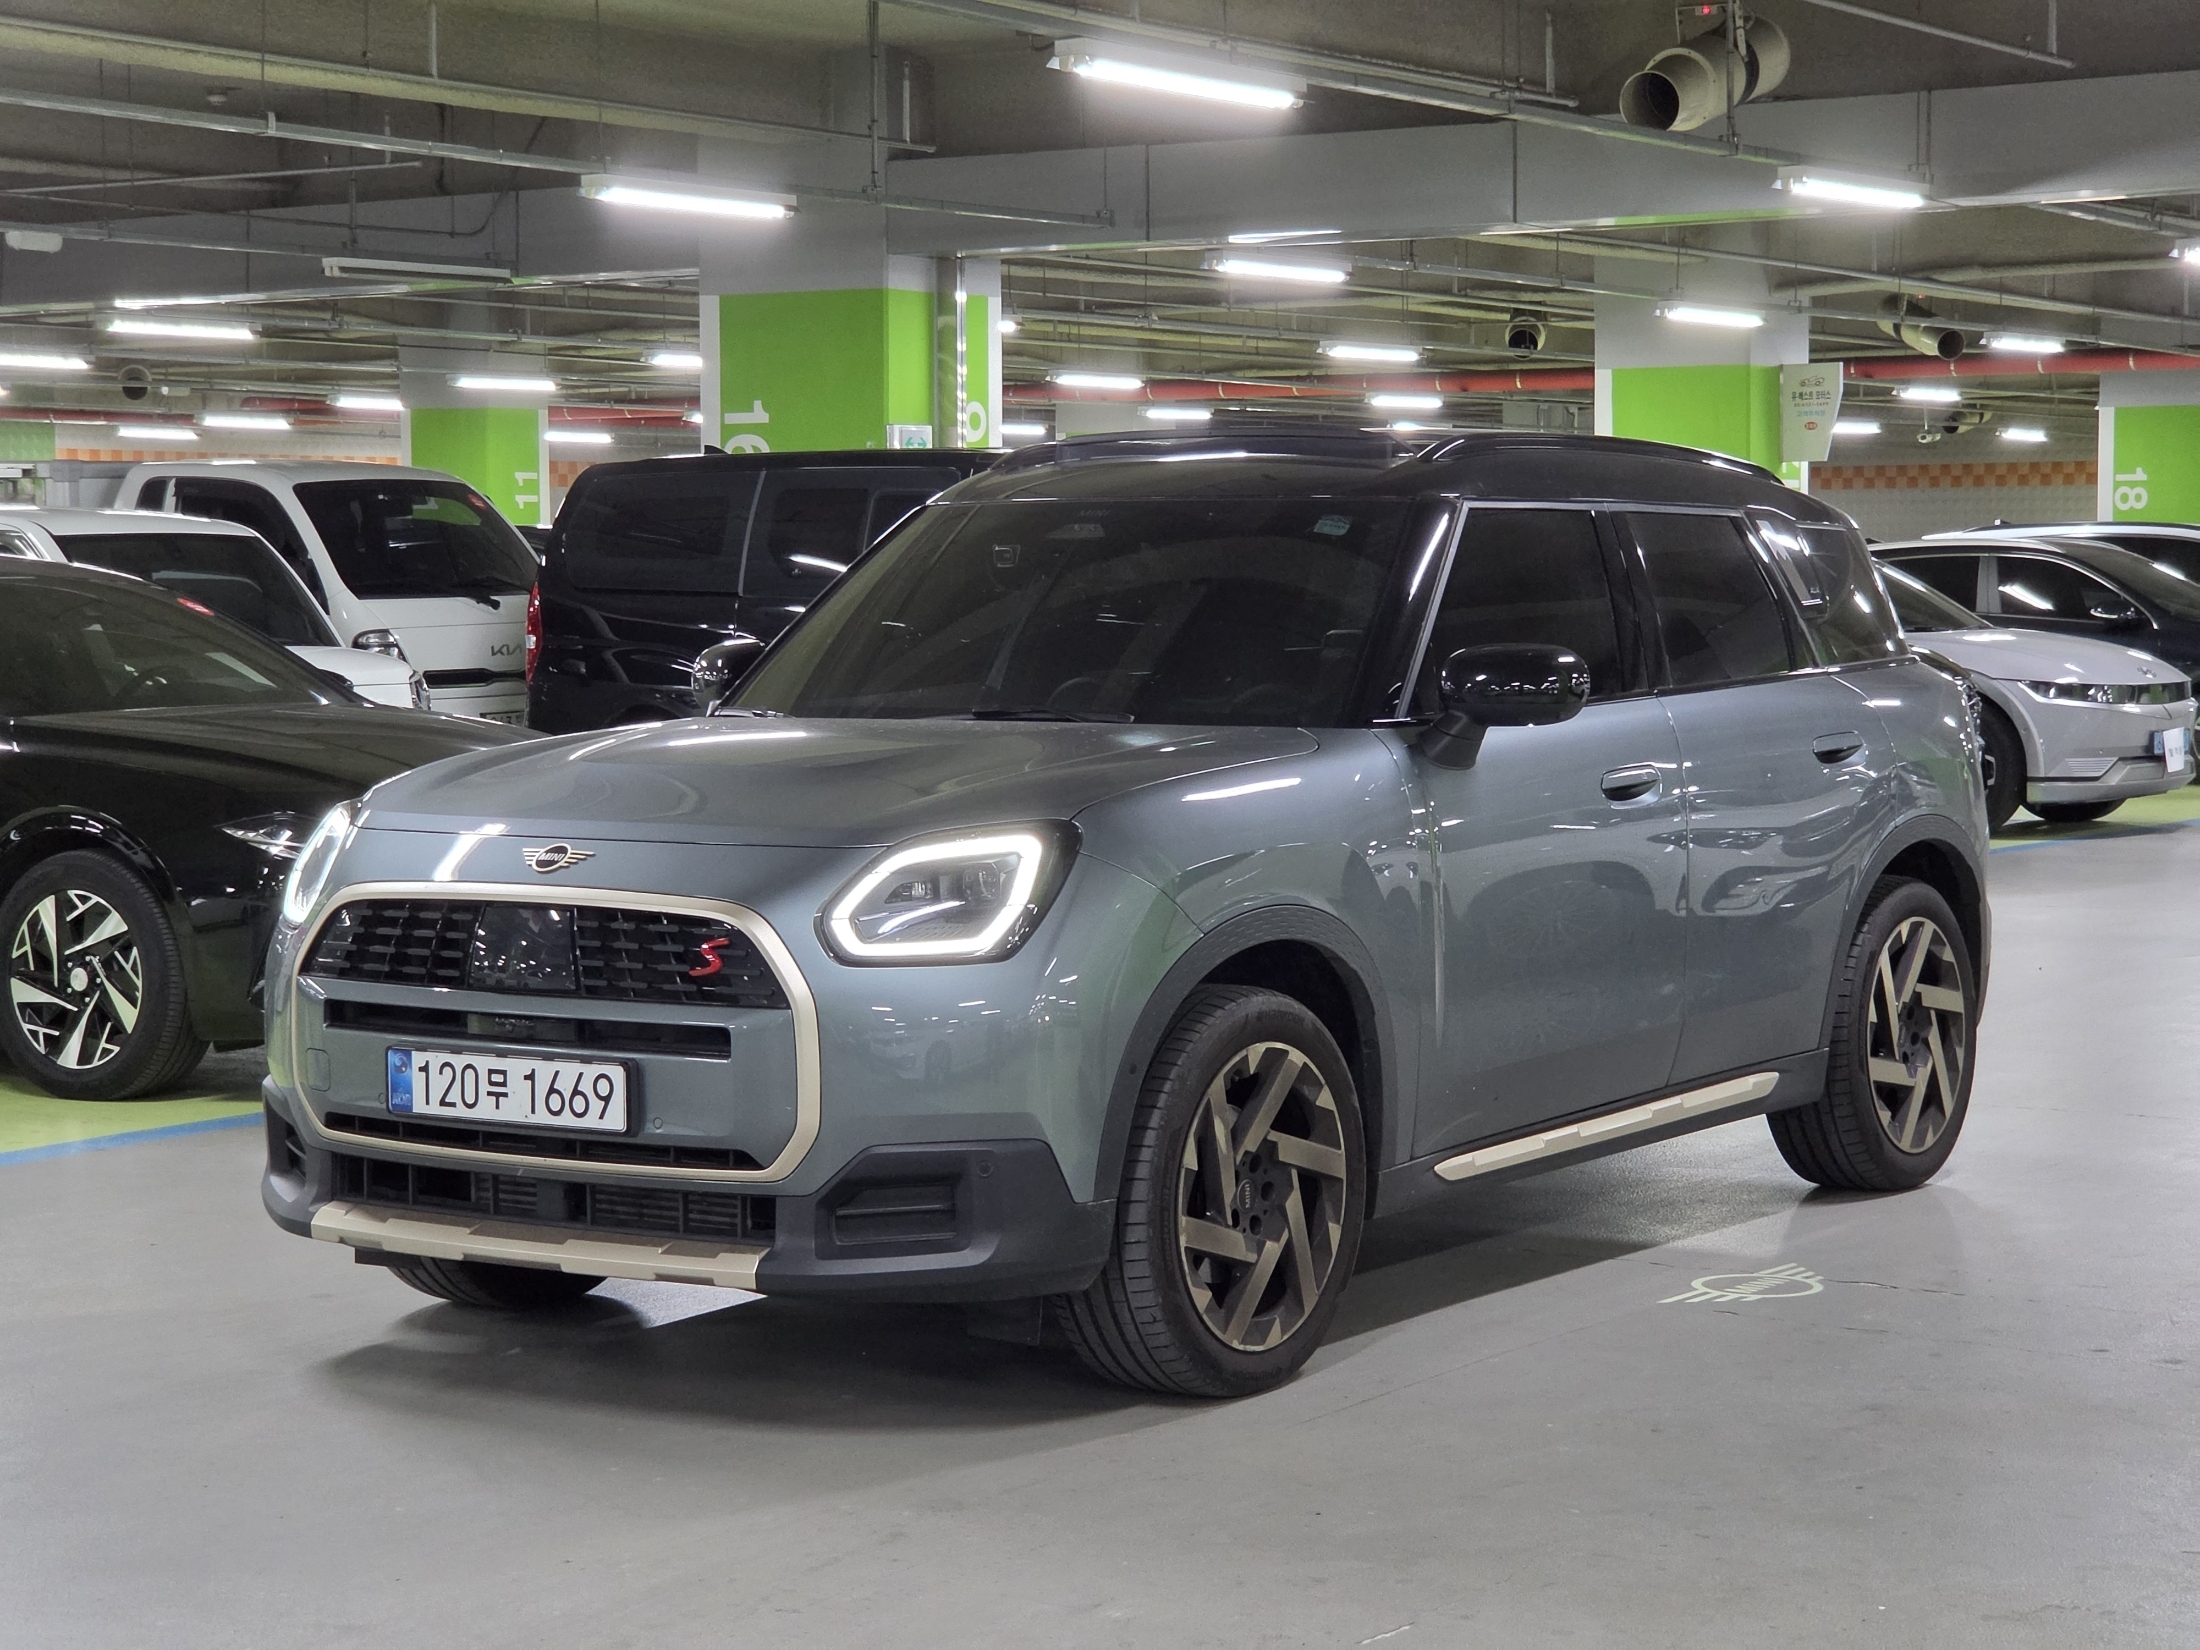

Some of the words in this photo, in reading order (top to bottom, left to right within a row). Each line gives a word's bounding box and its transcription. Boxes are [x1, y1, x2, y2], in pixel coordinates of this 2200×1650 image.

[514, 471, 539, 510] 11
[2114, 467, 2148, 511] 18
[490, 643, 523, 657] KIA
[537, 851, 566, 862] MINI
[688, 937, 731, 977] S
[417, 1059, 509, 1111] 120무
[523, 1067, 615, 1121] 1669
[1243, 1183, 1251, 1209] MINI
